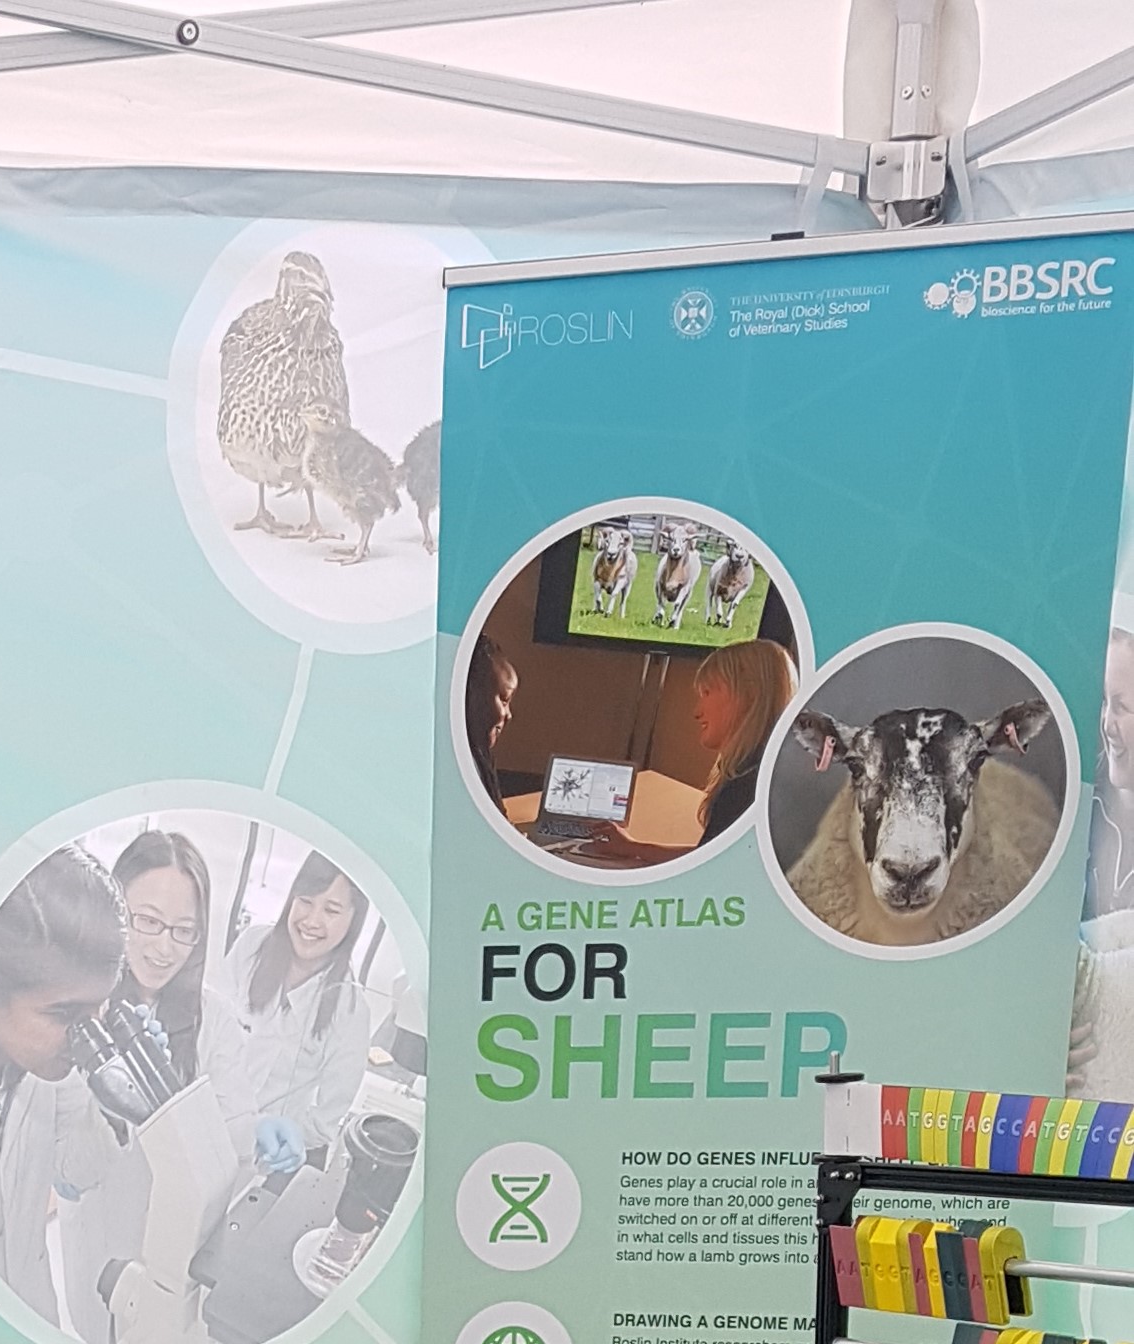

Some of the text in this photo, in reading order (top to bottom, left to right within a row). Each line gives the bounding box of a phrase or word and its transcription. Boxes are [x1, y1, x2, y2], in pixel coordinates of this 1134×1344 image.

[983, 257, 1116, 303] BBSRC
[754, 284, 890, 304] UNIVERSITY EDINBURGH
[730, 300, 870, 323] The Royal (Dick) School
[981, 299, 1112, 317] bioscience for the future
[517, 311, 633, 347] ROSLIN
[729, 318, 848, 338] of Veterinary Studies
[481, 896, 746, 932] A GENE ATLAS
[480, 942, 628, 1002] FOR
[475, 1011, 848, 1102] SHEEP
[622, 1152, 756, 1165] HOW DO GENES
[620, 1175, 802, 1191] Genes play crucial role in
[619, 1194, 773, 1209] have more than 20,000
[874, 1195, 1010, 1212] genome, which are
[618, 1213, 813, 1226] switched on or off at different
[617, 1231, 807, 1244] in what cells and tissues this
[616, 1250, 809, 1265] stand how lamb grows into
[613, 1314, 788, 1330] DRAWING A GENOME
